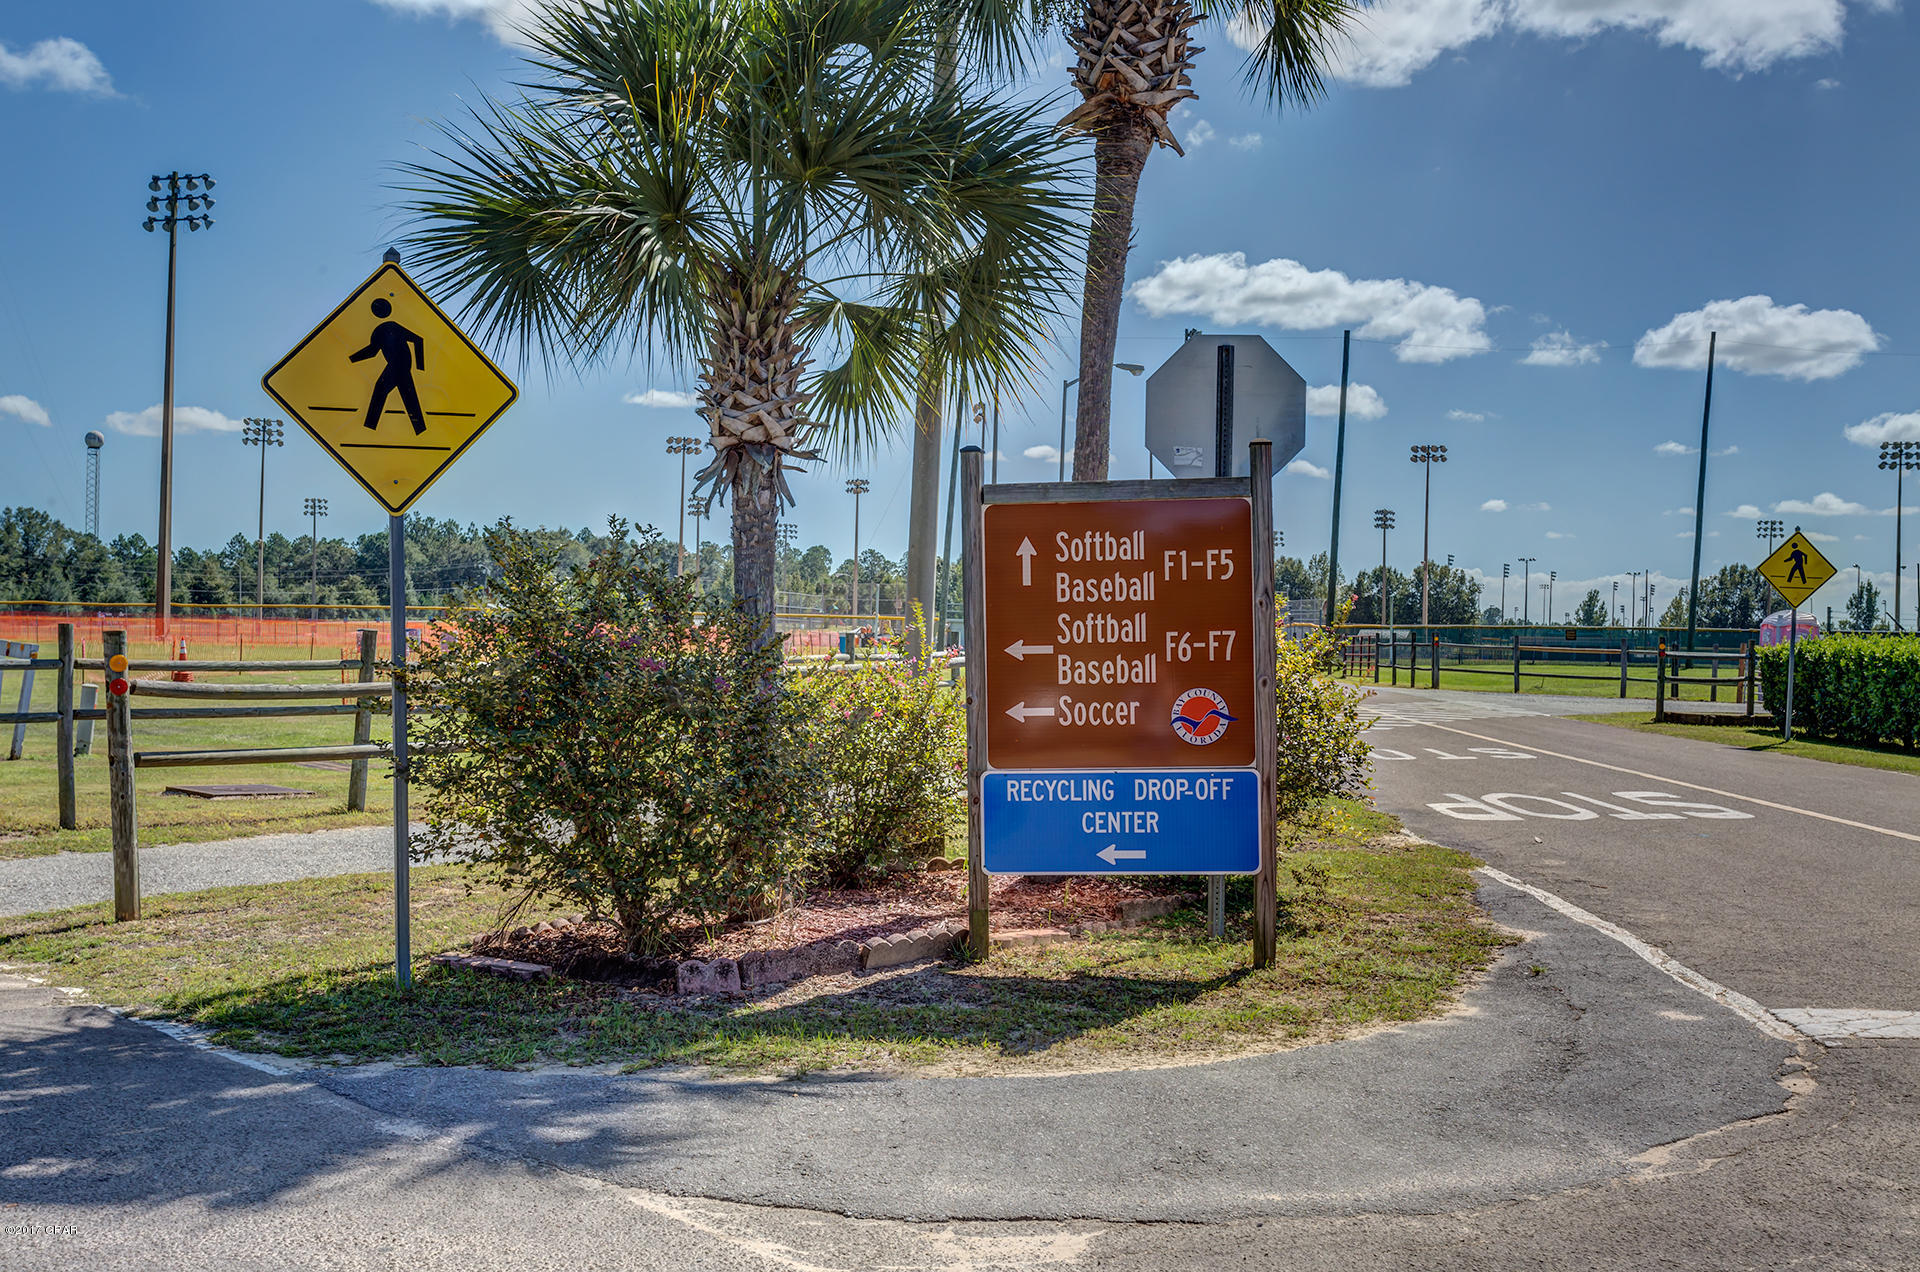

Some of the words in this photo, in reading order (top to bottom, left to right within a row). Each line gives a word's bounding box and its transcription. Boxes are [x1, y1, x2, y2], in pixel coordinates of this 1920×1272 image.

[1056, 530, 1145, 562] Softball
[1164, 549, 1234, 581] F1-F5
[1057, 571, 1155, 602] Baseball
[1057, 612, 1147, 644] Softball
[1166, 630, 1236, 662] F6-F7
[1058, 653, 1157, 685] Baseball
[1058, 695, 1140, 727] Soccer
[1173, 698, 1185, 715] BAY
[1187, 689, 1226, 711] COUNTY
[1175, 723, 1226, 744] FLORIDA
[1367, 747, 1538, 760] STO
[1007, 779, 1114, 802] RECYCLING
[1134, 778, 1234, 801] DROP-OFF
[1425, 791, 1755, 821] STOP
[1082, 811, 1159, 834] CENTER
